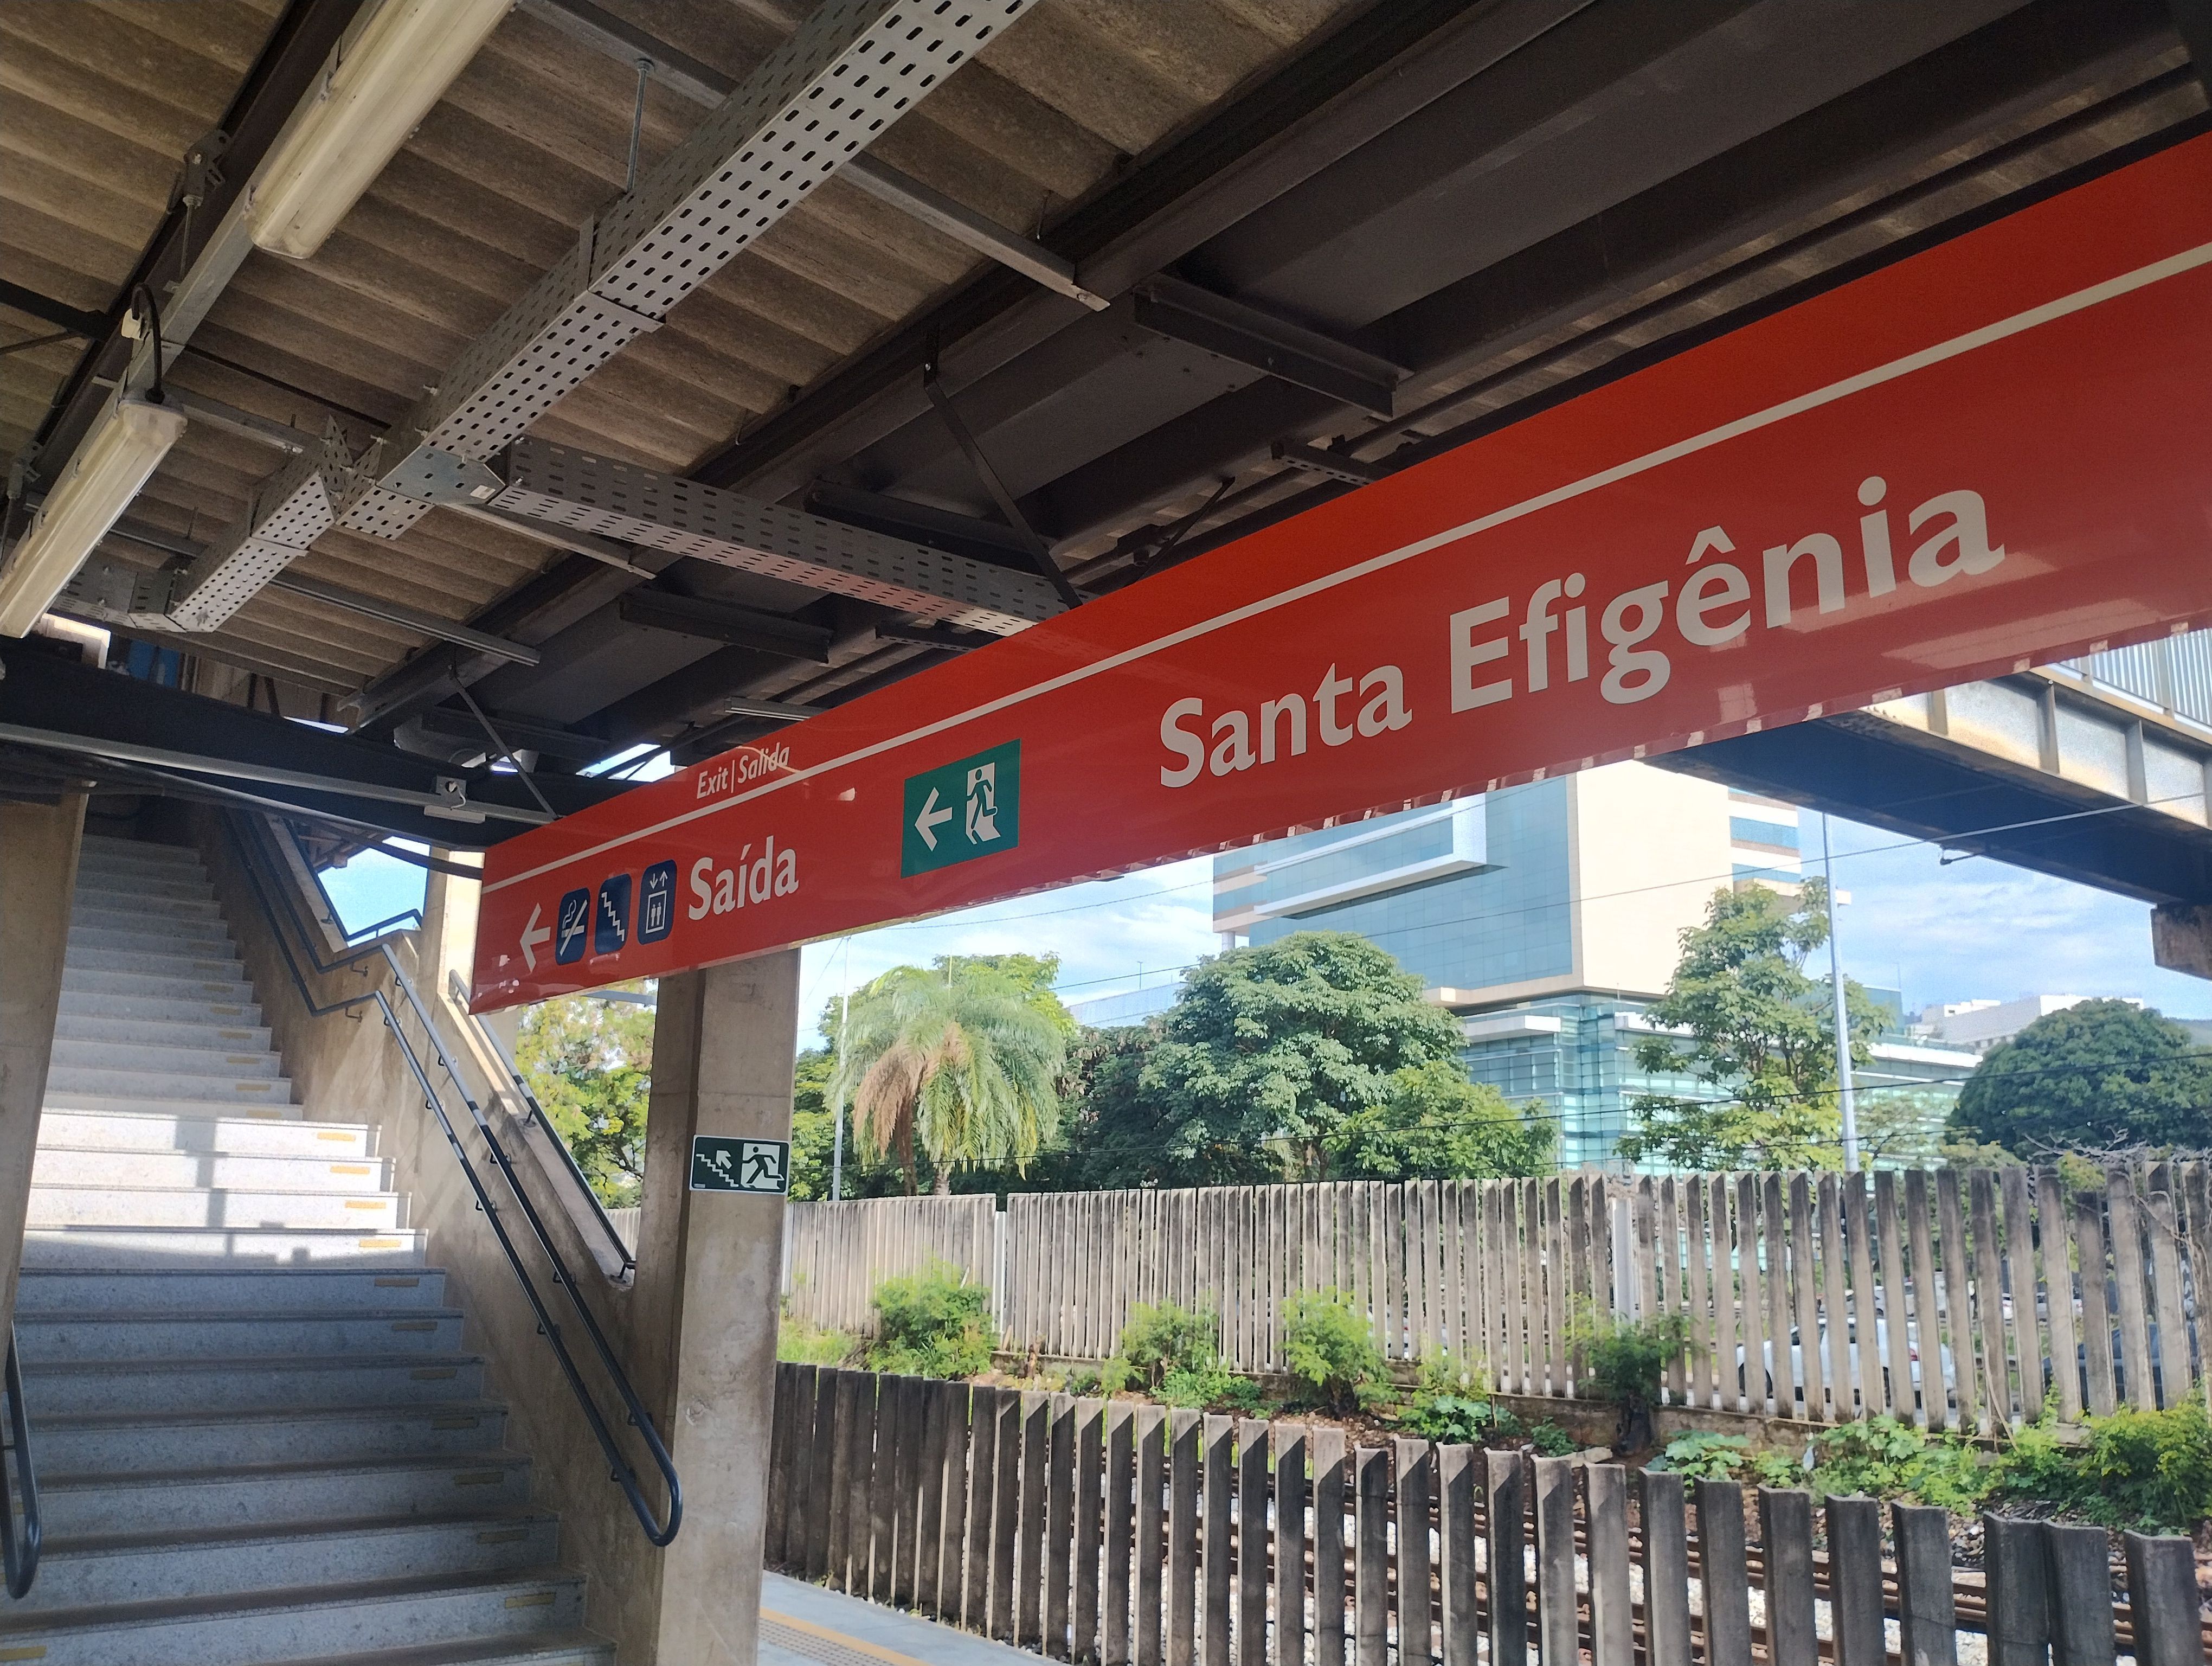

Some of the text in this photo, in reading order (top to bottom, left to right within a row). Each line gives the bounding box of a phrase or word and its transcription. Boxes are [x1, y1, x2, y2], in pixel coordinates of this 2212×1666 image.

[1161, 476, 2005, 788] Santa Efigênia
[697, 742, 790, 799] Exit Salida
[689, 836, 799, 920] Saída
